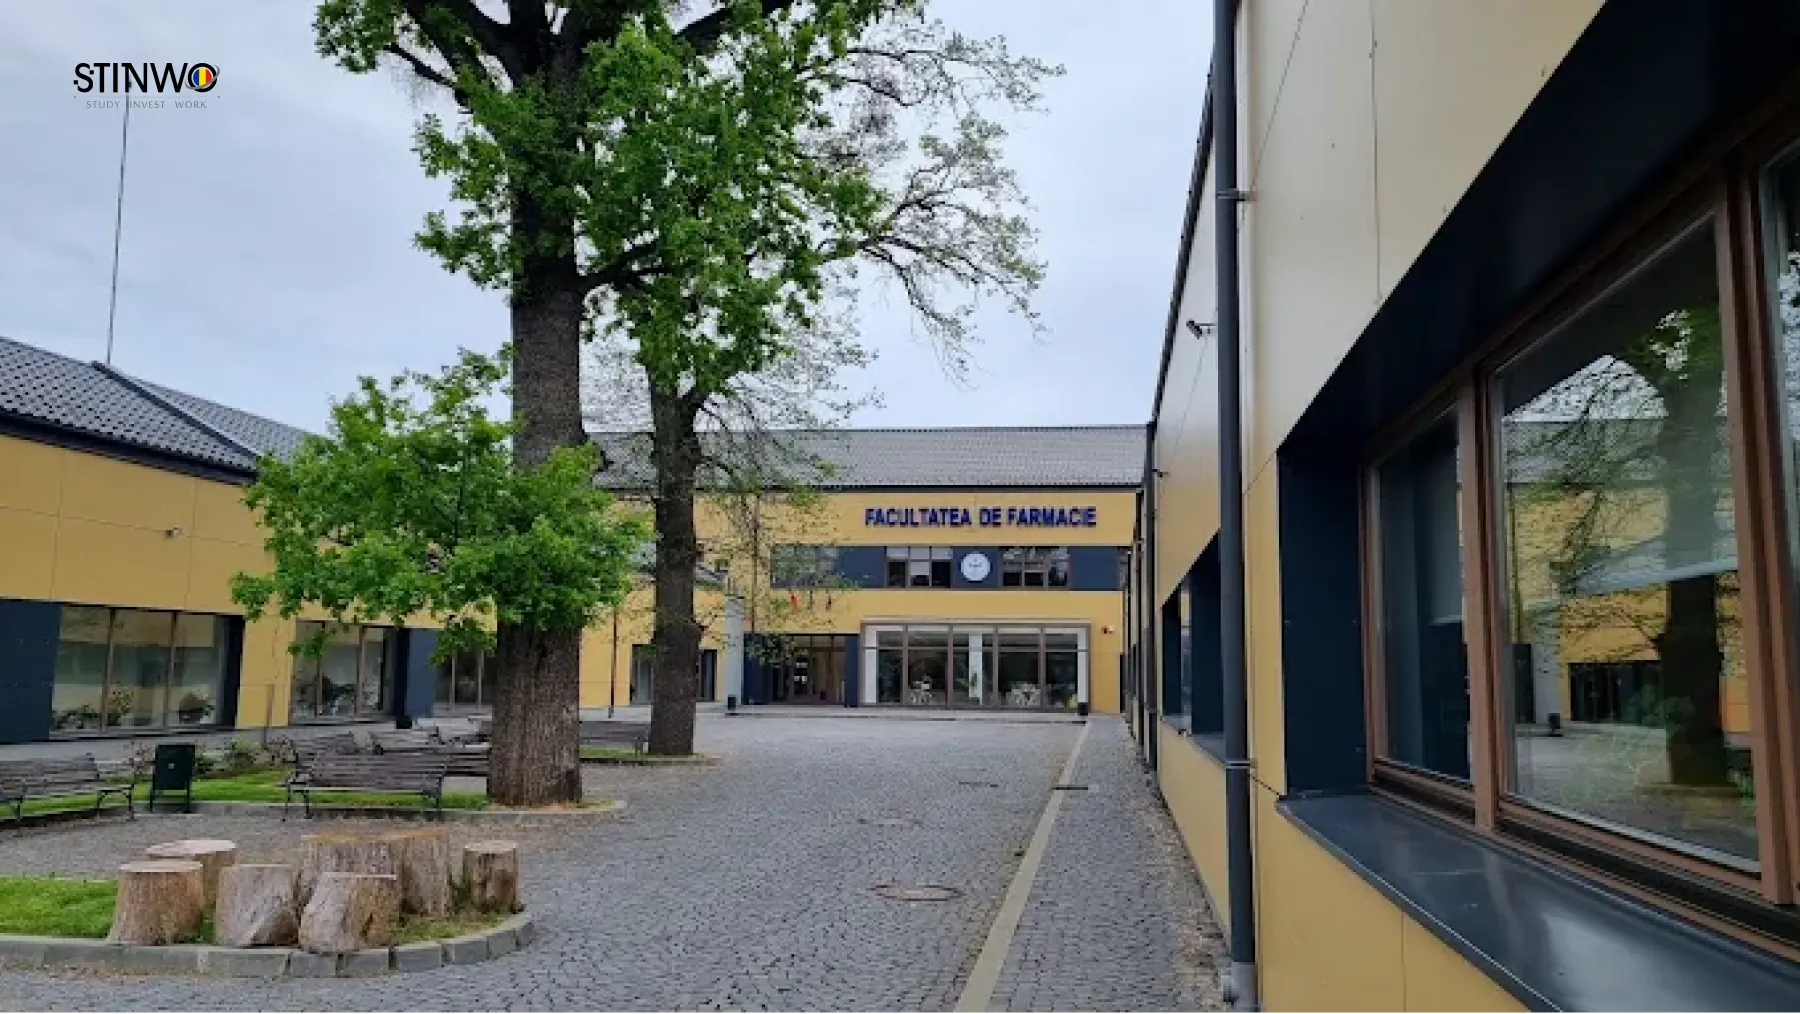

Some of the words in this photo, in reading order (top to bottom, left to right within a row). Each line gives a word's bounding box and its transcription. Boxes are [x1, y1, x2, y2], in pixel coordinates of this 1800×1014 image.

[864, 507, 972, 527] FACULTATEA
[979, 507, 1002, 527] DE
[1007, 507, 1097, 527] FARMACIE
